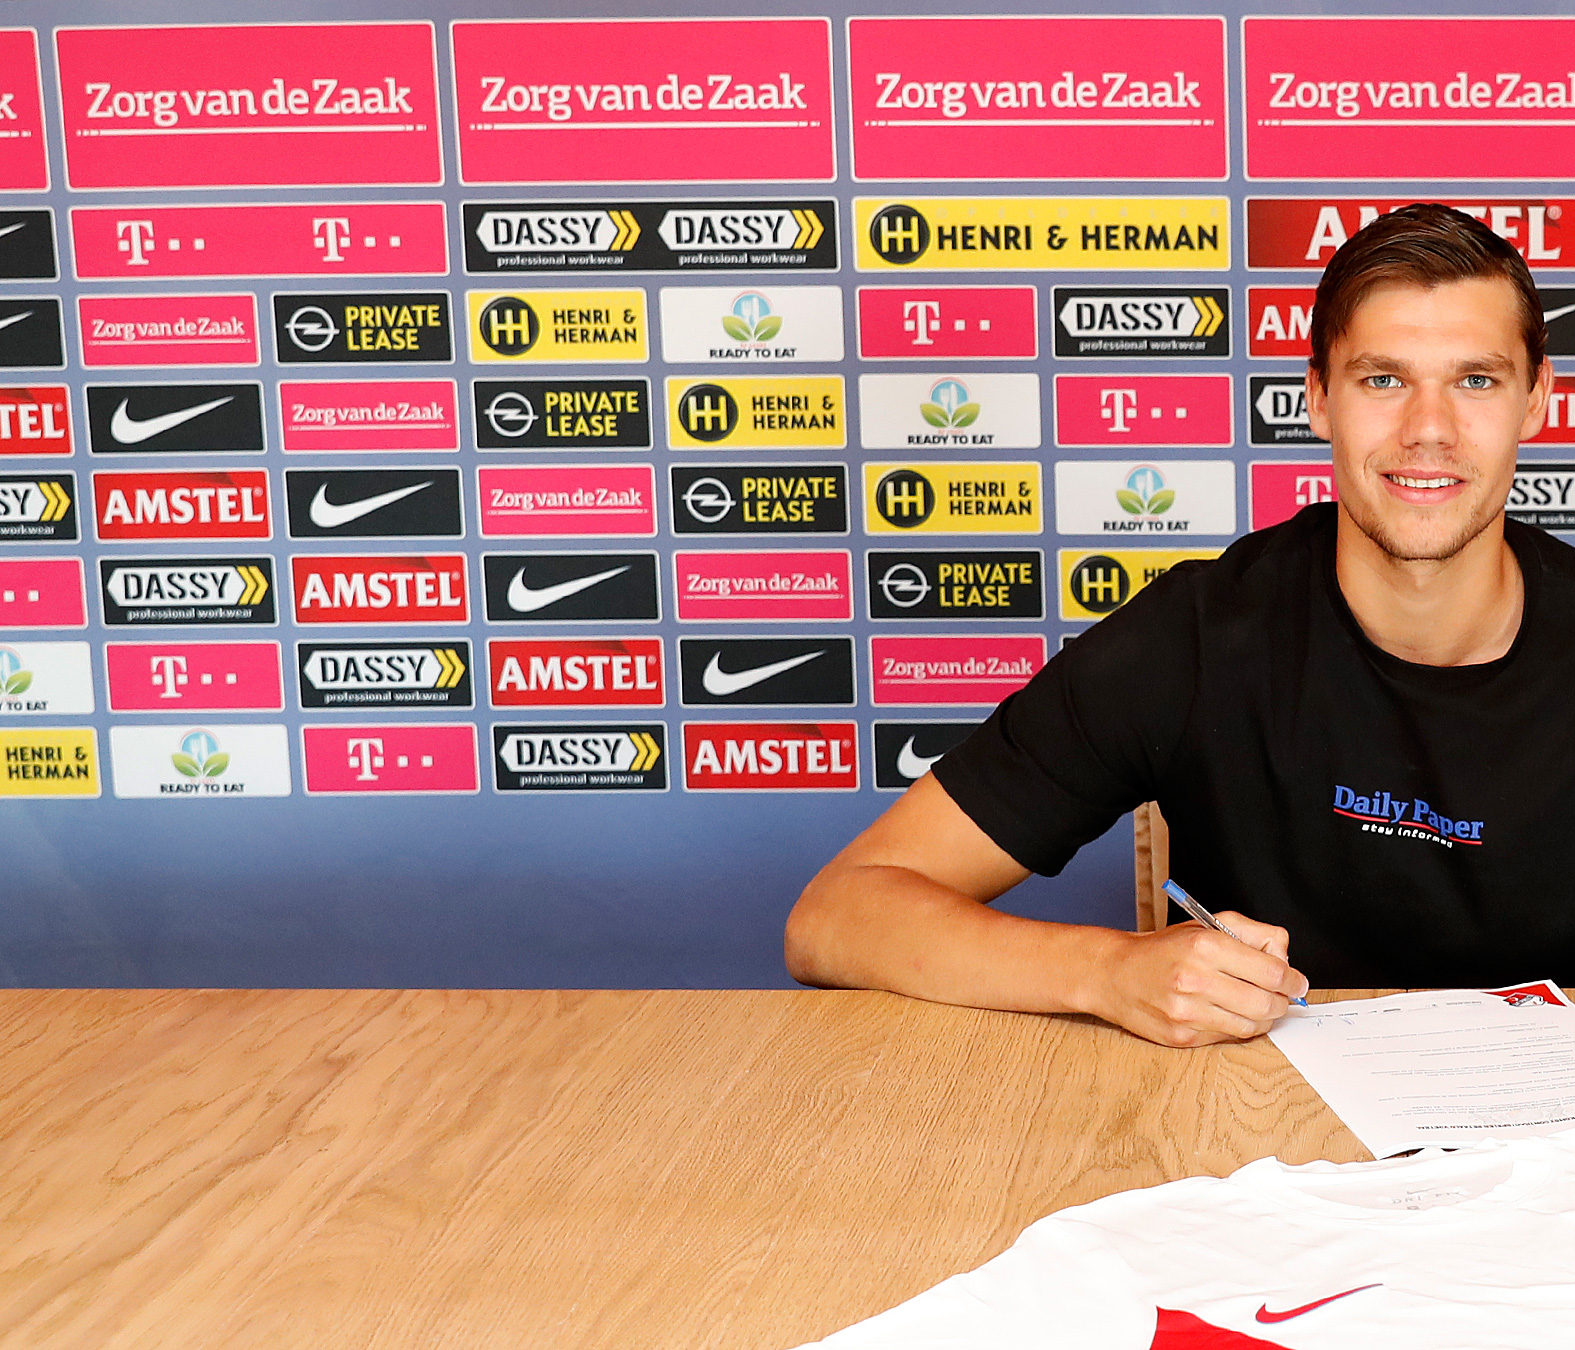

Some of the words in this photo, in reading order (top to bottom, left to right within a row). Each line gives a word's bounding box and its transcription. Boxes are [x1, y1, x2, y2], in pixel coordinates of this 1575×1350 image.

[86, 82, 179, 127] Zorg
[181, 90, 258, 116] van
[261, 79, 309, 115] de
[312, 78, 412, 114] Zaak
[481, 76, 573, 121] Zorg
[575, 85, 652, 111] van
[656, 74, 703, 110] de
[707, 74, 806, 110] Zaak
[876, 73, 967, 117] Zorg
[971, 82, 1046, 108] van
[1051, 72, 1097, 107] de
[1102, 72, 1200, 107] Zaak
[1270, 73, 1361, 117] Zorg
[1364, 82, 1440, 108] van
[1444, 72, 1491, 108] de
[493, 217, 602, 246] DASSY
[675, 216, 783, 244] DASSY
[937, 225, 1031, 251] HENRI
[1047, 225, 1069, 251] &
[1081, 225, 1219, 251] HERMAN
[497, 254, 566, 267] professional
[568, 254, 624, 265] workwear
[678, 254, 747, 266] professional
[749, 254, 807, 264] workwear
[345, 305, 441, 327] PRIVATE
[553, 309, 610, 325] HENRI
[624, 309, 636, 323] &
[1077, 303, 1184, 330] DASSY
[92, 318, 137, 341] Zorg
[136, 322, 172, 336] van
[172, 317, 198, 336] de
[197, 316, 245, 335] Zaak
[556, 328, 636, 343] HERMAN
[347, 329, 420, 350] LEASE
[544, 392, 640, 413] PRIVATE
[752, 396, 808, 411] HENRI
[822, 396, 834, 409] &
[292, 403, 337, 426] Zorg
[336, 407, 372, 421] van
[372, 402, 398, 421] de
[397, 401, 445, 420] Zaak
[754, 415, 834, 430] HERMAN
[546, 415, 618, 436] LEASE
[908, 435, 949, 445] READY
[952, 435, 968, 444] TO
[972, 435, 994, 444] EAT
[491, 488, 535, 510] Zorg
[535, 492, 570, 506] van
[571, 487, 596, 506] de
[595, 487, 643, 506] Zaak
[742, 478, 837, 499] PRIVATE
[949, 482, 1005, 497] HENRI
[1019, 482, 1031, 495] &
[743, 501, 815, 521] LEASE
[951, 500, 1031, 516] HERMAN
[688, 573, 731, 595] Zorg
[731, 577, 766, 591] van
[767, 572, 792, 591] de
[792, 572, 839, 591] Zaak
[938, 563, 1033, 584] PRIVATE
[123, 572, 230, 600] DASSY
[939, 586, 1011, 607] LEASE
[127, 609, 195, 621] professional
[197, 609, 252, 618] workwear
[320, 656, 427, 683] DASSY
[884, 658, 926, 679] Zorg
[927, 662, 961, 675] van
[963, 657, 987, 675] de
[987, 657, 1033, 675] Zaak
[324, 692, 392, 704] professional
[394, 692, 448, 701] workwear
[516, 739, 622, 765] DASSY
[1333, 784, 1409, 824] Daily
[1413, 799, 1484, 839] Paper
[1362, 824, 1394, 836] stay
